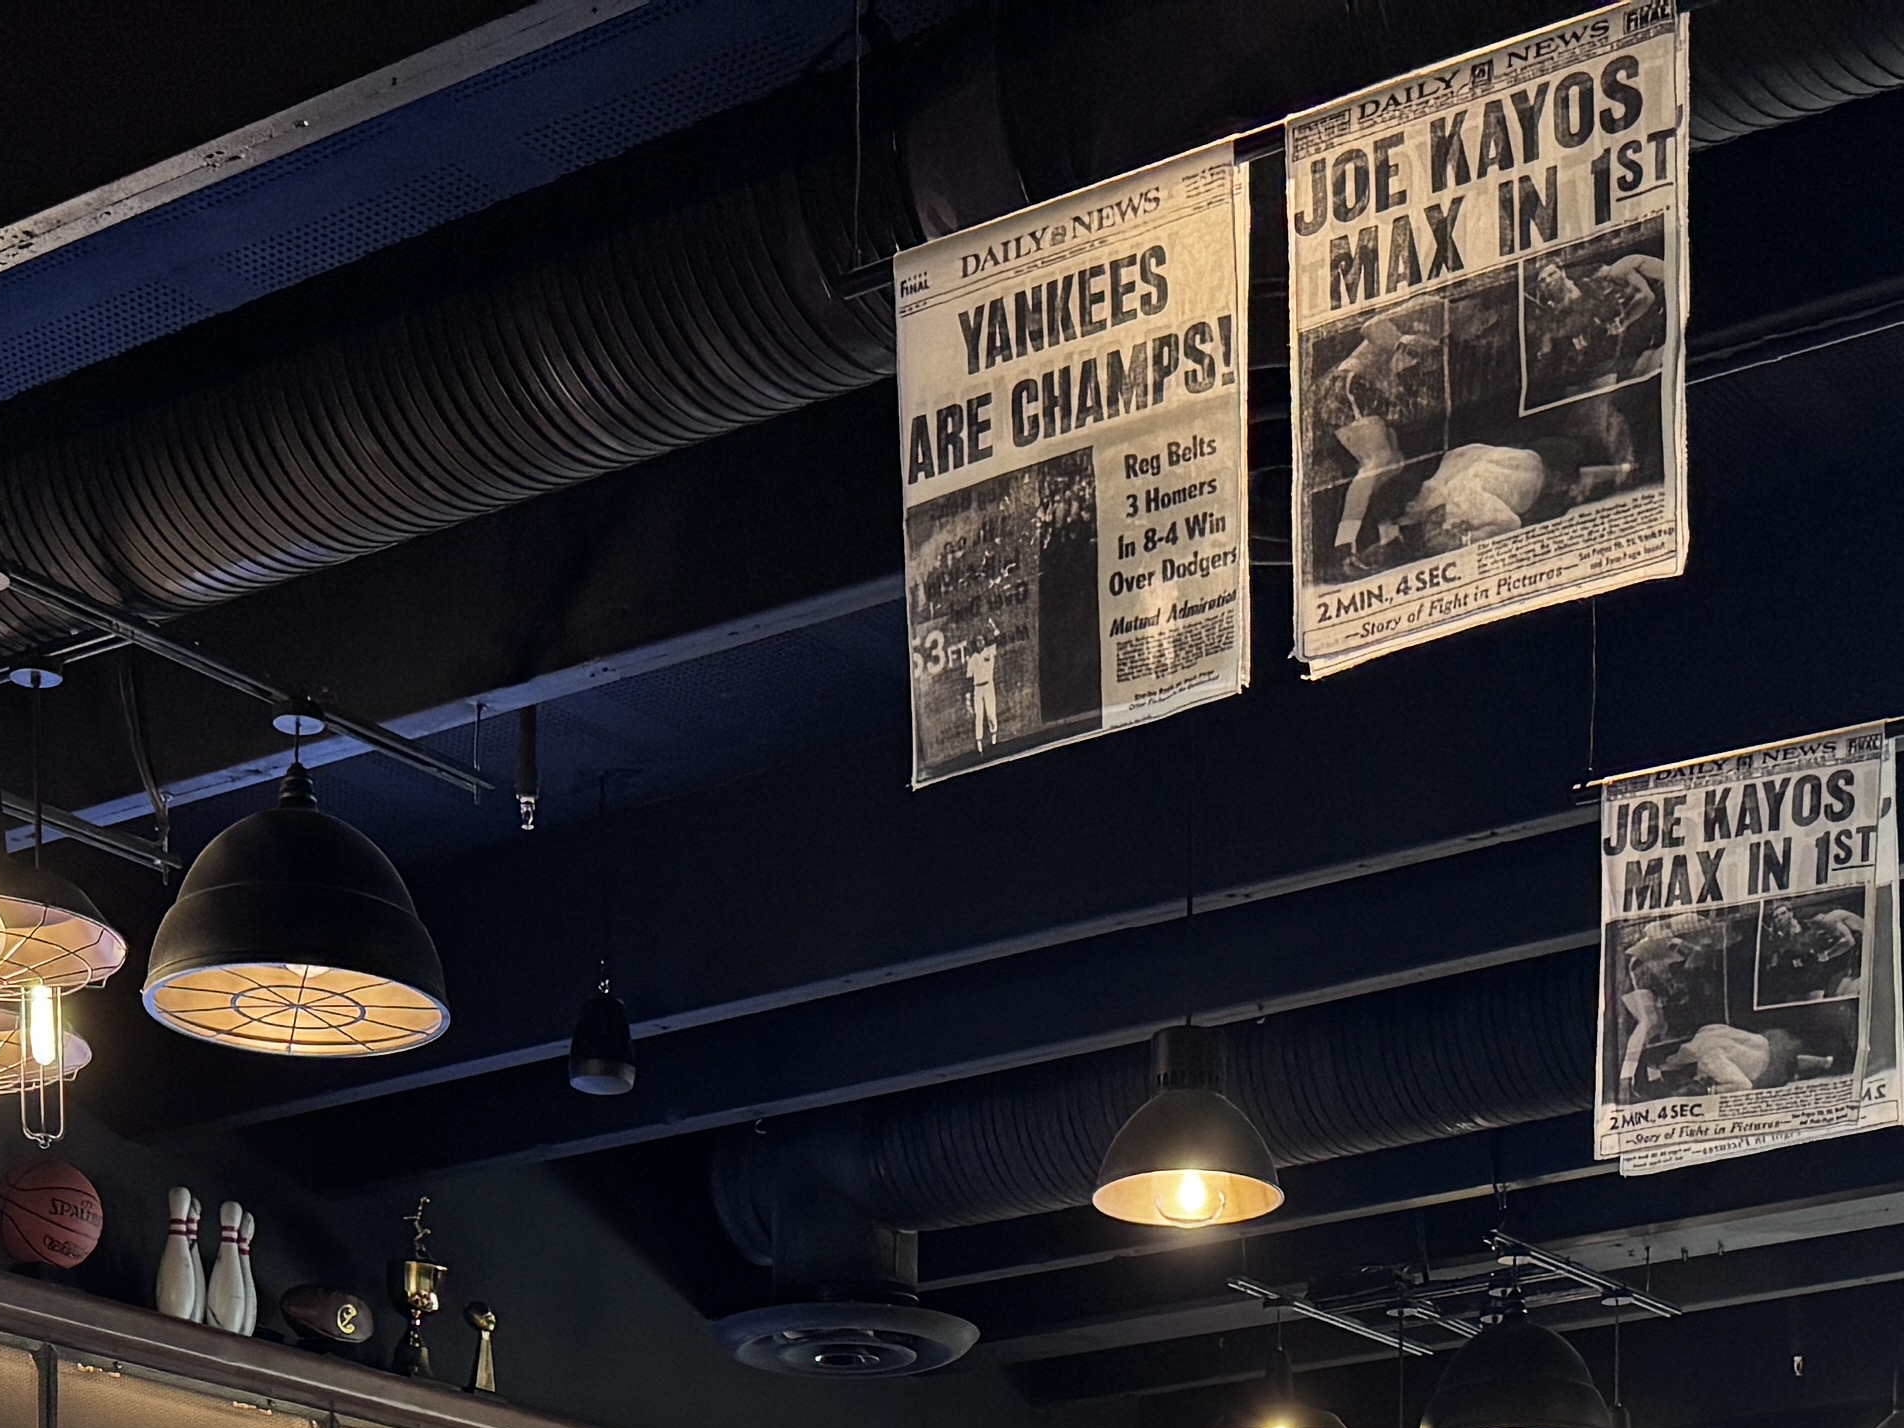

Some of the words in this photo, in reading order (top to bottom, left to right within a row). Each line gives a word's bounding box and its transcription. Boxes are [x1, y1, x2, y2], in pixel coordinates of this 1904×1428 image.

[1357, 70, 1462, 121] DAILY
[1507, 17, 1610, 69] NEWS
[1294, 135, 1406, 237] JOE
[1428, 53, 1644, 195] KAYOS
[961, 226, 1051, 278] DAILY
[1069, 186, 1161, 239] NEWS
[1328, 195, 1464, 312] MAX
[1497, 165, 1558, 256] IN
[1592, 127, 1677, 226] 1ST
[958, 245, 1169, 376] YANKEES
[908, 391, 993, 485] ARE
[1011, 313, 1236, 448] CHAMPS!
[1124, 453, 1161, 480] Reg
[1167, 435, 1217, 467] Belts
[1126, 493, 1139, 518] 3
[1146, 478, 1217, 513] Homers
[1118, 534, 1136, 561] In
[1144, 521, 1179, 553] 8-4
[1185, 511, 1226, 541] Win
[1109, 570, 1155, 597] Over
[1162, 546, 1237, 583] Dodgers
[1395, 574, 1412, 598] 4
[1414, 561, 1463, 594] SEC.
[1110, 607, 1161, 637] Mutual
[1407, 604, 1426, 625] of
[1428, 592, 1470, 618] Fight
[1472, 585, 1491, 603] in
[1655, 760, 1727, 782] DAILY
[1762, 741, 1838, 765] NEWS
[1603, 794, 1688, 857] JOE
[1703, 769, 1856, 843] KAYOS
[1623, 847, 1726, 913] MAX
[1748, 837, 1793, 897] IN
[1815, 825, 1878, 886] 1ST
[1657, 1106, 1670, 1120] 4
